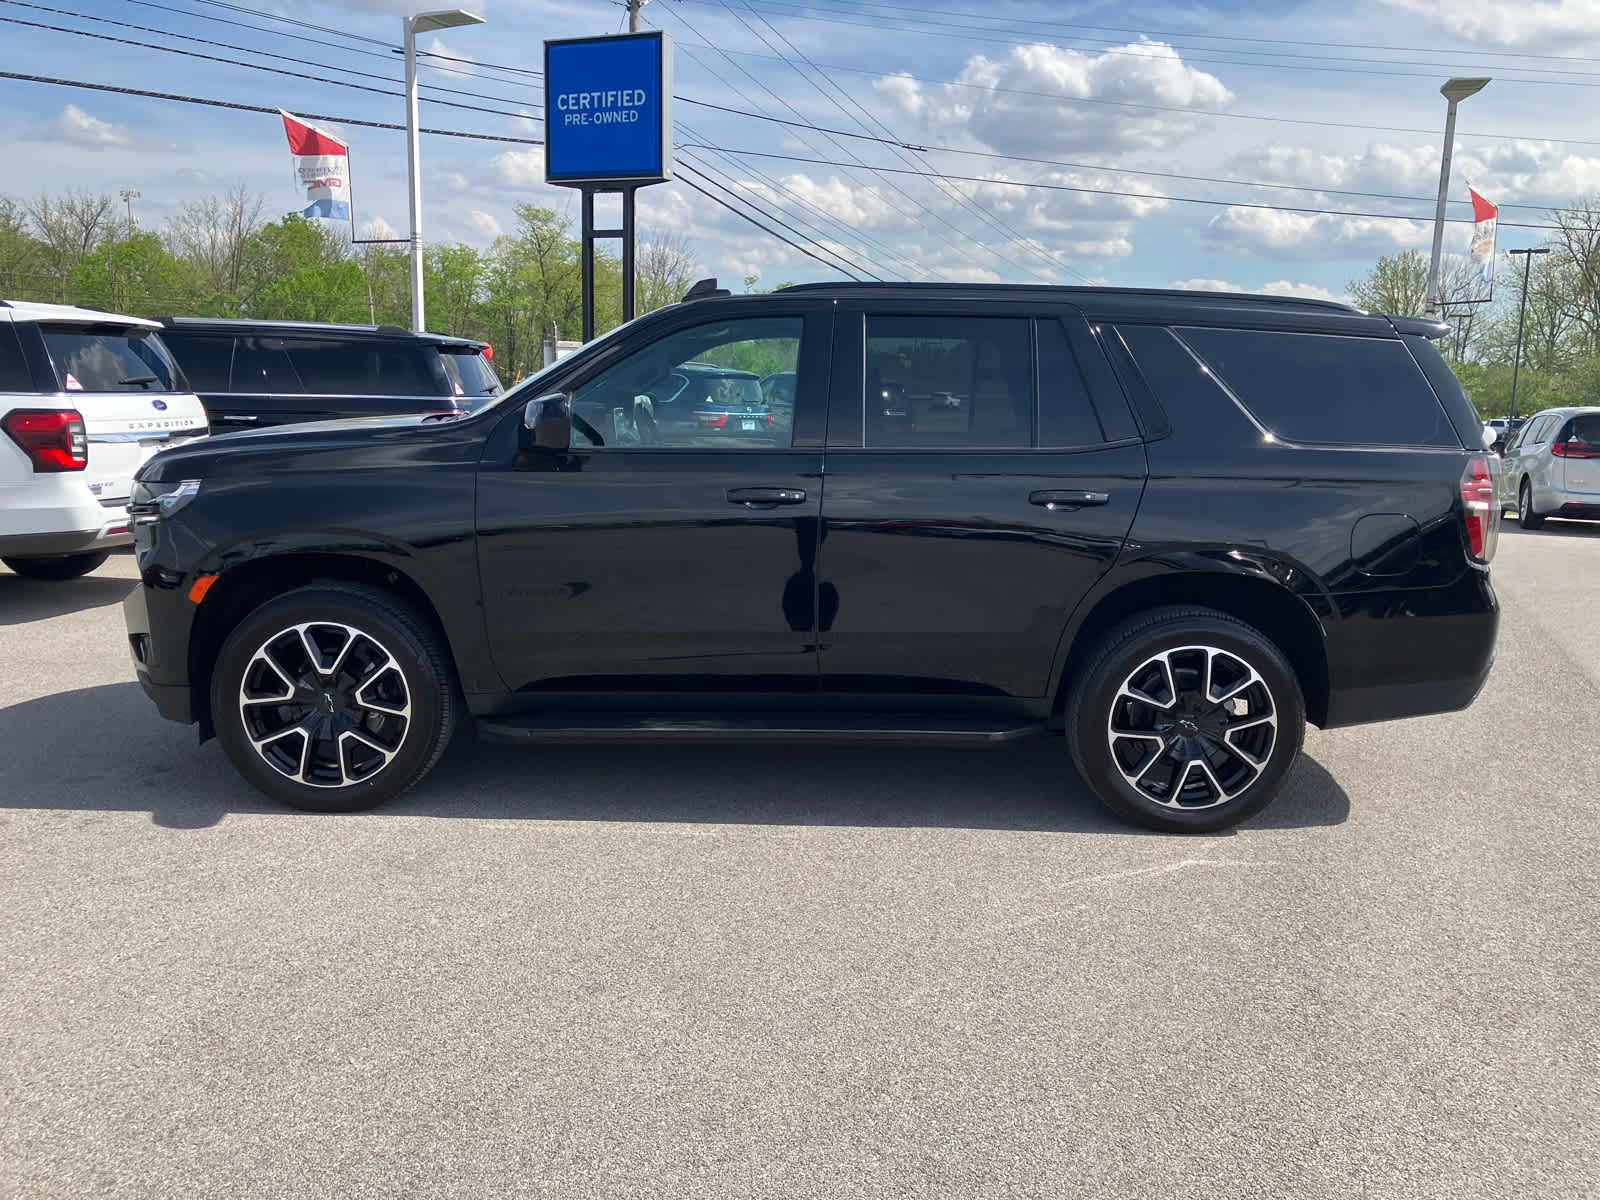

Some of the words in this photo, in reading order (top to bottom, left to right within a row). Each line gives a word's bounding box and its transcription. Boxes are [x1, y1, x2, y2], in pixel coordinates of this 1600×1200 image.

[557, 89, 646, 111] CERTIFIED
[564, 110, 638, 126] PRE-OWNED
[128, 420, 194, 430] EXPEDITION
